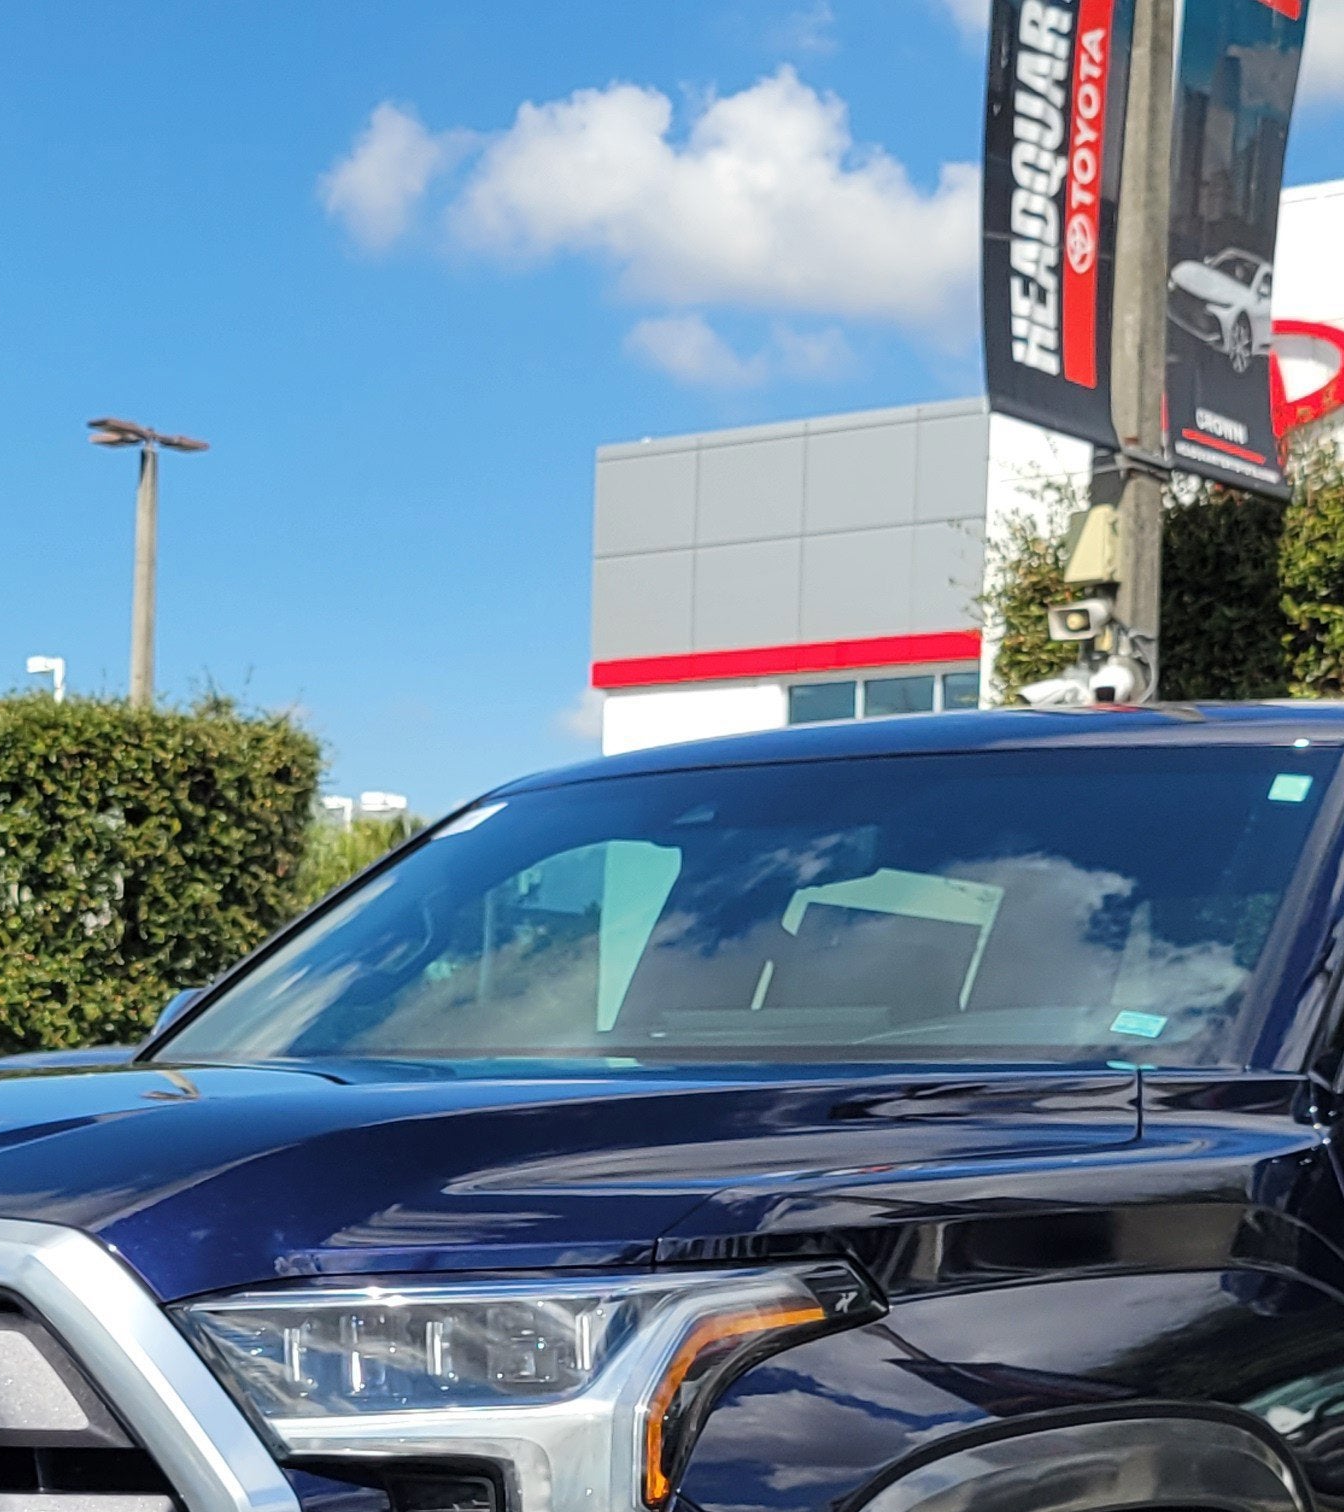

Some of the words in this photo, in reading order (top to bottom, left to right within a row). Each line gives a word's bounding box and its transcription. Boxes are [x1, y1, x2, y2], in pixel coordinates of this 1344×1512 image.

[1010, 0, 1074, 376] HEADQUAR
[1071, 27, 1106, 210] TOYOTA
[1195, 407, 1248, 445] CROWN
